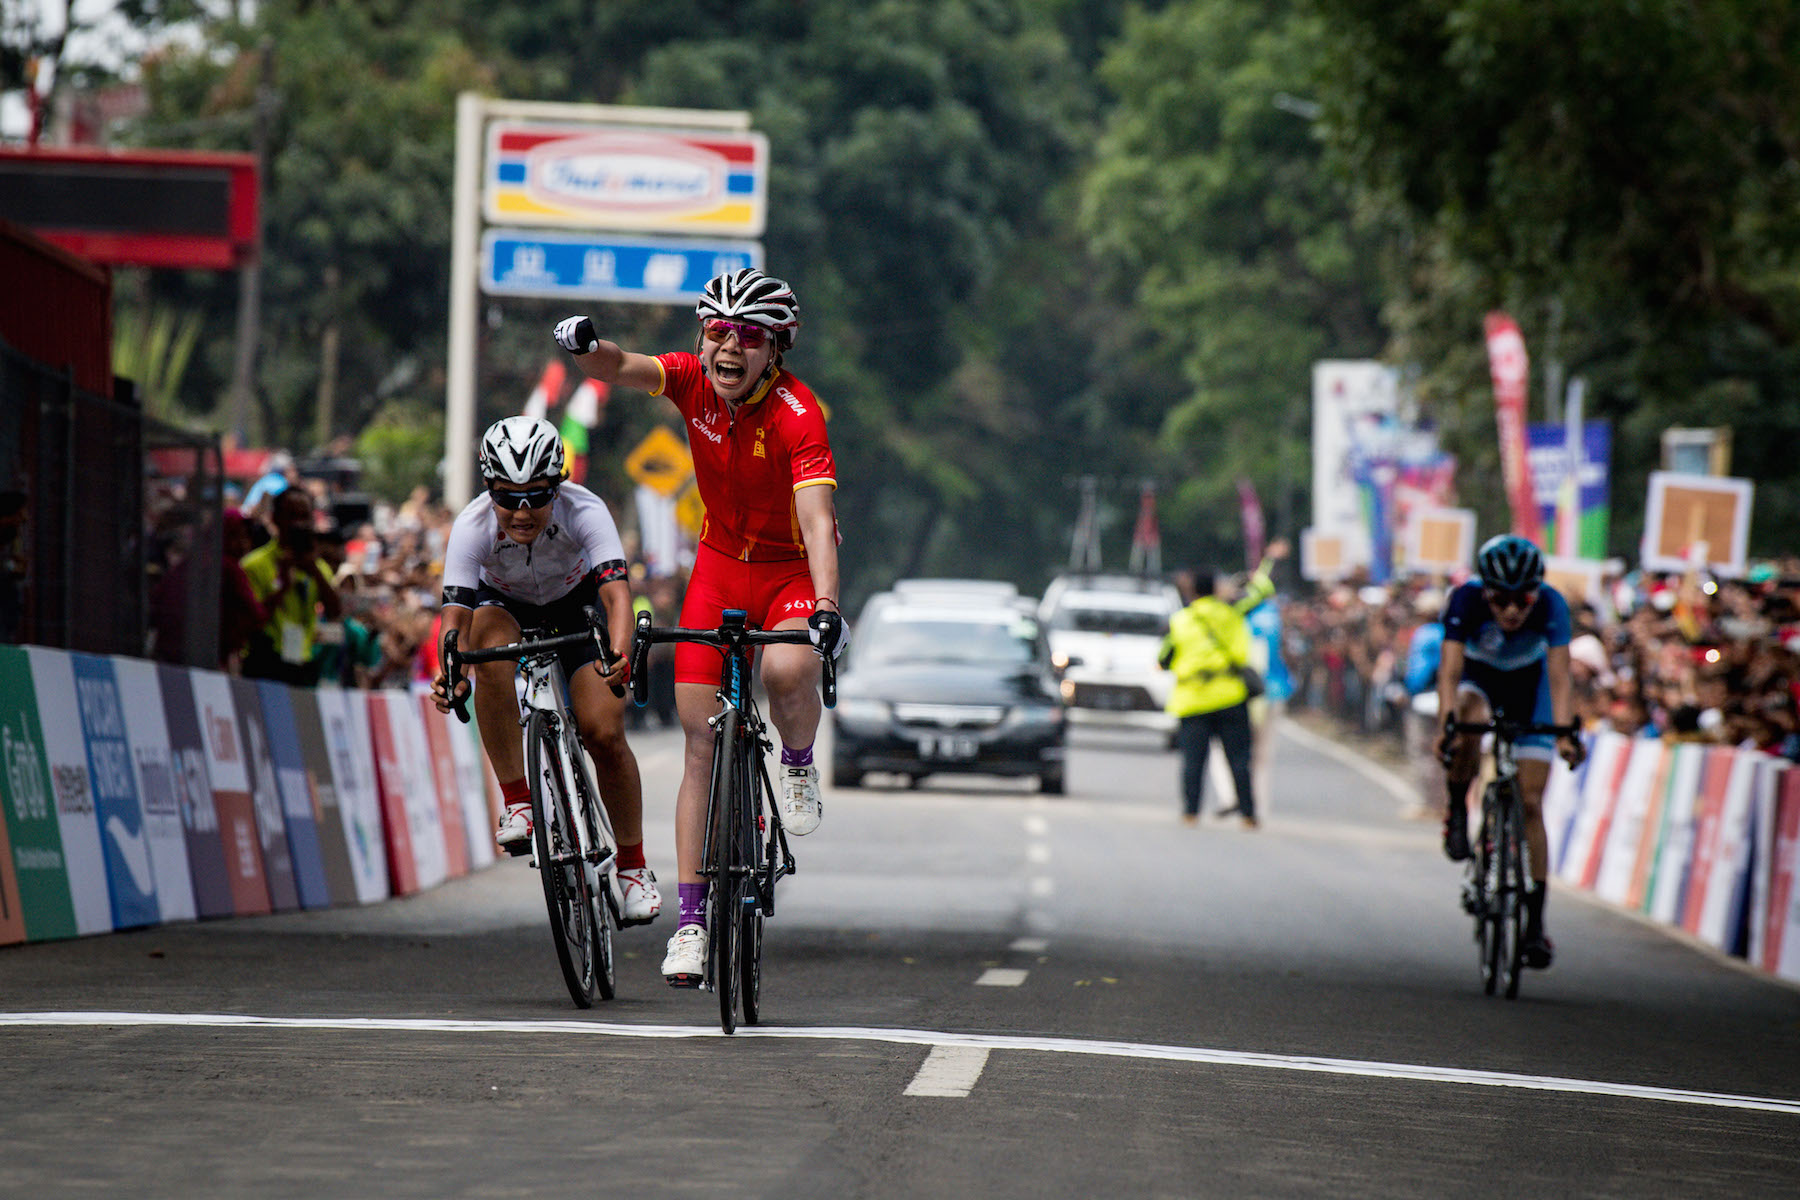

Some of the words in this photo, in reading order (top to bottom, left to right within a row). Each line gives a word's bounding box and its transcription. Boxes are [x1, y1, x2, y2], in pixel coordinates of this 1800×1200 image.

[776, 387, 807, 416] CHINA
[692, 417, 722, 444] CHINA
[731, 656, 741, 710] GIANT
[2, 710, 48, 822] Grab
